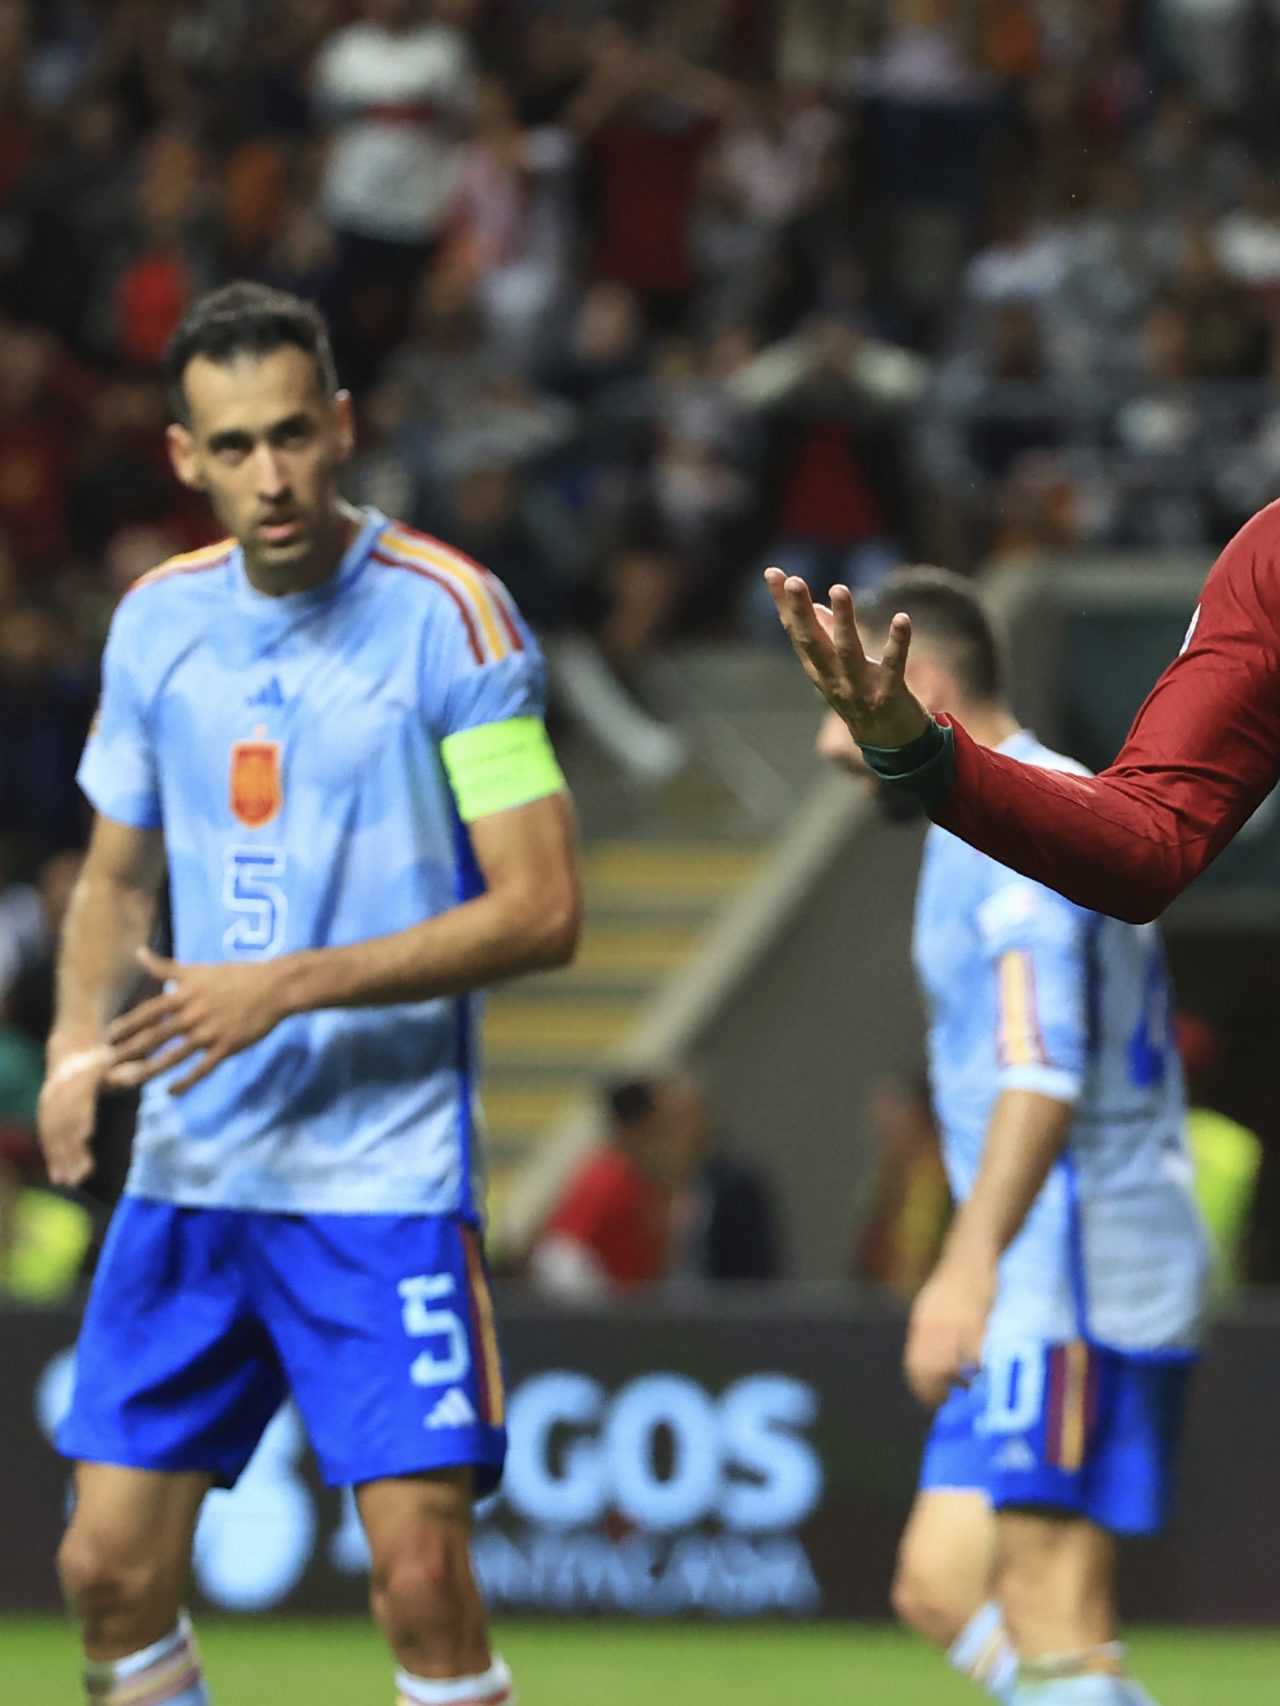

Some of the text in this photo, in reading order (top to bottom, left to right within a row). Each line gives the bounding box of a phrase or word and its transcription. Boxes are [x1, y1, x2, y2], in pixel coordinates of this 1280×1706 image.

[222, 844, 288, 963] 5
[397, 1272, 471, 1388] 5
[978, 1337, 1043, 1434] 0
[470, 1368, 826, 1535] GOS
